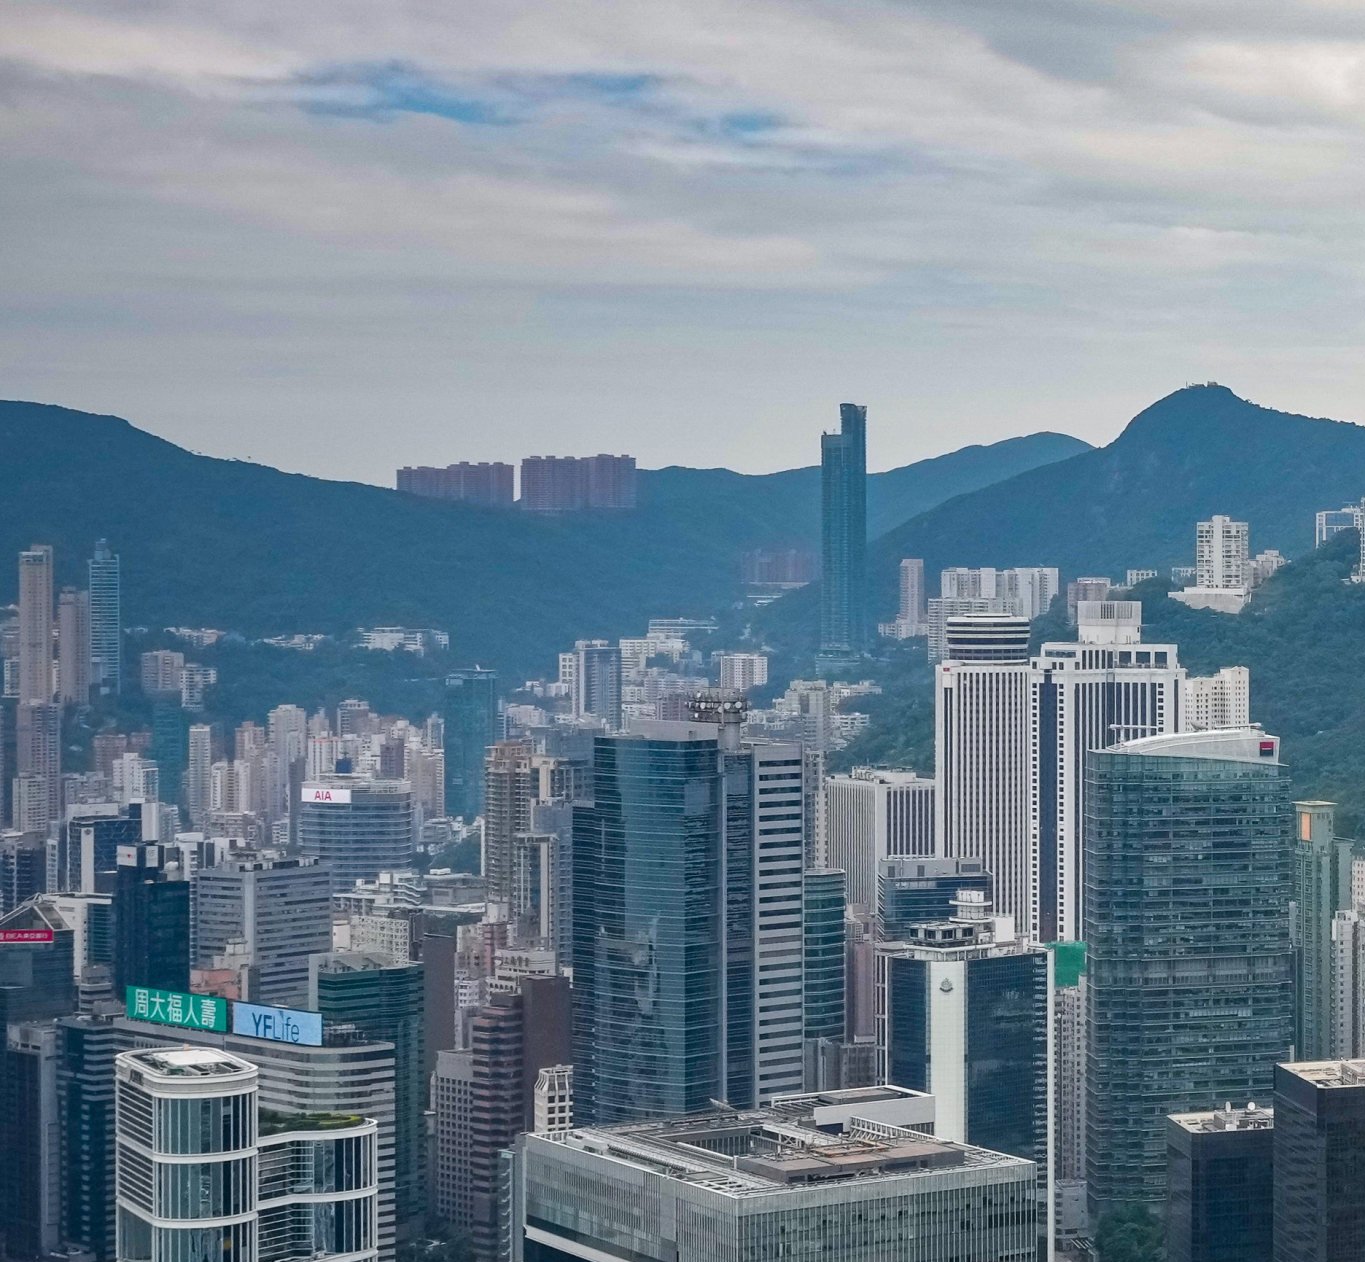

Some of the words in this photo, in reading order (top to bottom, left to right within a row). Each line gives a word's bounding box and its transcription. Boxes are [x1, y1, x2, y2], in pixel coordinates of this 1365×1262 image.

[314, 790, 332, 801] AIA
[133, 988, 216, 1028] 周大福人壽
